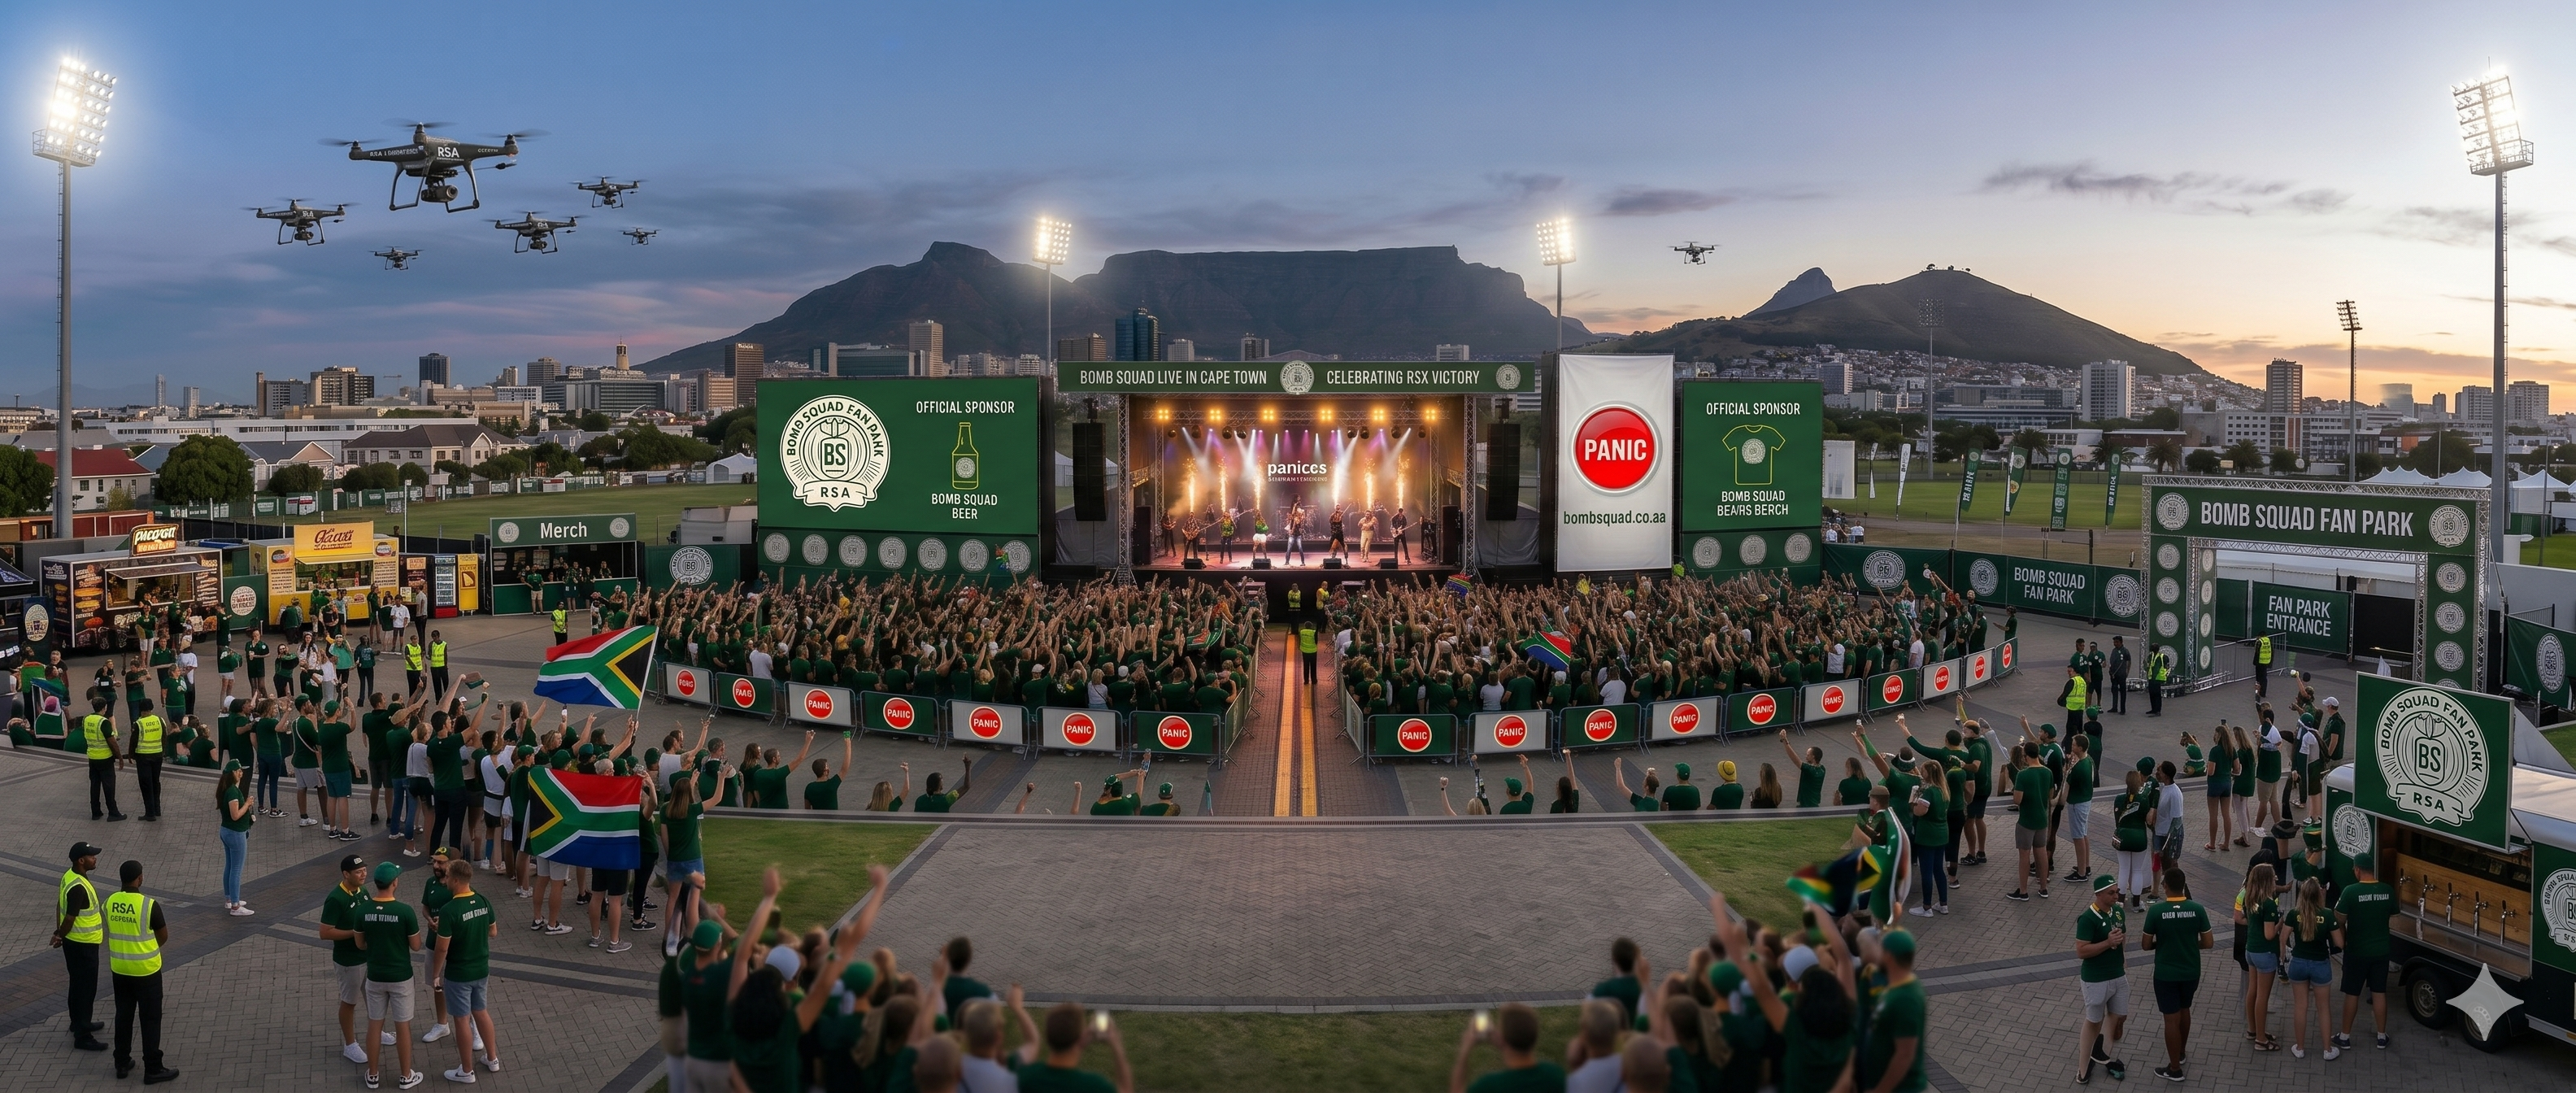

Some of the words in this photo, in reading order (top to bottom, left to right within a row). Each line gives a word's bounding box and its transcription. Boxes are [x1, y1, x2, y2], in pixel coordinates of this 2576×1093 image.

[437, 146, 459, 158] RSA
[1080, 370, 1113, 384] BOMB
[1116, 370, 1155, 385] SQUAD
[1158, 370, 1182, 384] LIVE
[1186, 370, 1198, 384] IN
[1200, 370, 1230, 384] CAPE
[1234, 370, 1267, 384] TOWN
[1327, 370, 1403, 384] CELEBRATING
[1407, 370, 1429, 384] RSX
[1432, 370, 1480, 384] VICTORY
[803, 401, 844, 423] SQUAD
[916, 400, 963, 414] OFFICIAL
[965, 400, 1015, 414] SPONSOR
[1706, 403, 1751, 416] OFFICIAL
[1753, 403, 1800, 416] SPONSOR
[824, 443, 846, 466] BS
[1585, 439, 1647, 461] PANIC
[820, 487, 851, 499] RSA
[931, 493, 961, 505] BOMB
[964, 493, 998, 507] SQUAD
[1721, 491, 1750, 502] BOMB
[1752, 490, 1786, 503] SQUAD
[951, 507, 978, 520] BEER
[1755, 503, 1788, 516] BERCH
[1564, 511, 1666, 527] bombsquad.co.aa
[2201, 501, 2250, 527] BOMB
[2255, 504, 2315, 531] SQUAD
[2320, 507, 2356, 533] FAN
[2361, 510, 2414, 537] PARK
[540, 522, 588, 539] Merch
[2014, 567, 2046, 584] BOMB
[2047, 571, 2086, 590] SQUAD
[2024, 585, 2044, 600] FAN
[2046, 587, 2075, 605] PARK
[2269, 595, 2293, 614] FAN
[2296, 599, 2331, 619] PARK
[2266, 612, 2331, 637] ENTRANCE
[808, 699, 830, 711] PANIC
[1751, 704, 1774, 716] PANIC
[973, 717, 999, 729] PANIC
[1589, 721, 1613, 731] PANIC
[1673, 714, 1697, 725] PANIC
[2381, 710, 2399, 749] BOMB
[2397, 695, 2439, 712] SQUAD
[2443, 702, 2468, 729] FAN
[1066, 724, 1092, 735] PANIC
[1162, 727, 1188, 738] PANIC
[1402, 730, 1428, 741] PANIC
[1498, 727, 1524, 738] PANIC
[2418, 742, 2441, 772] BS
[2413, 792, 2445, 812] RSA
[111, 902, 136, 915] RSA
